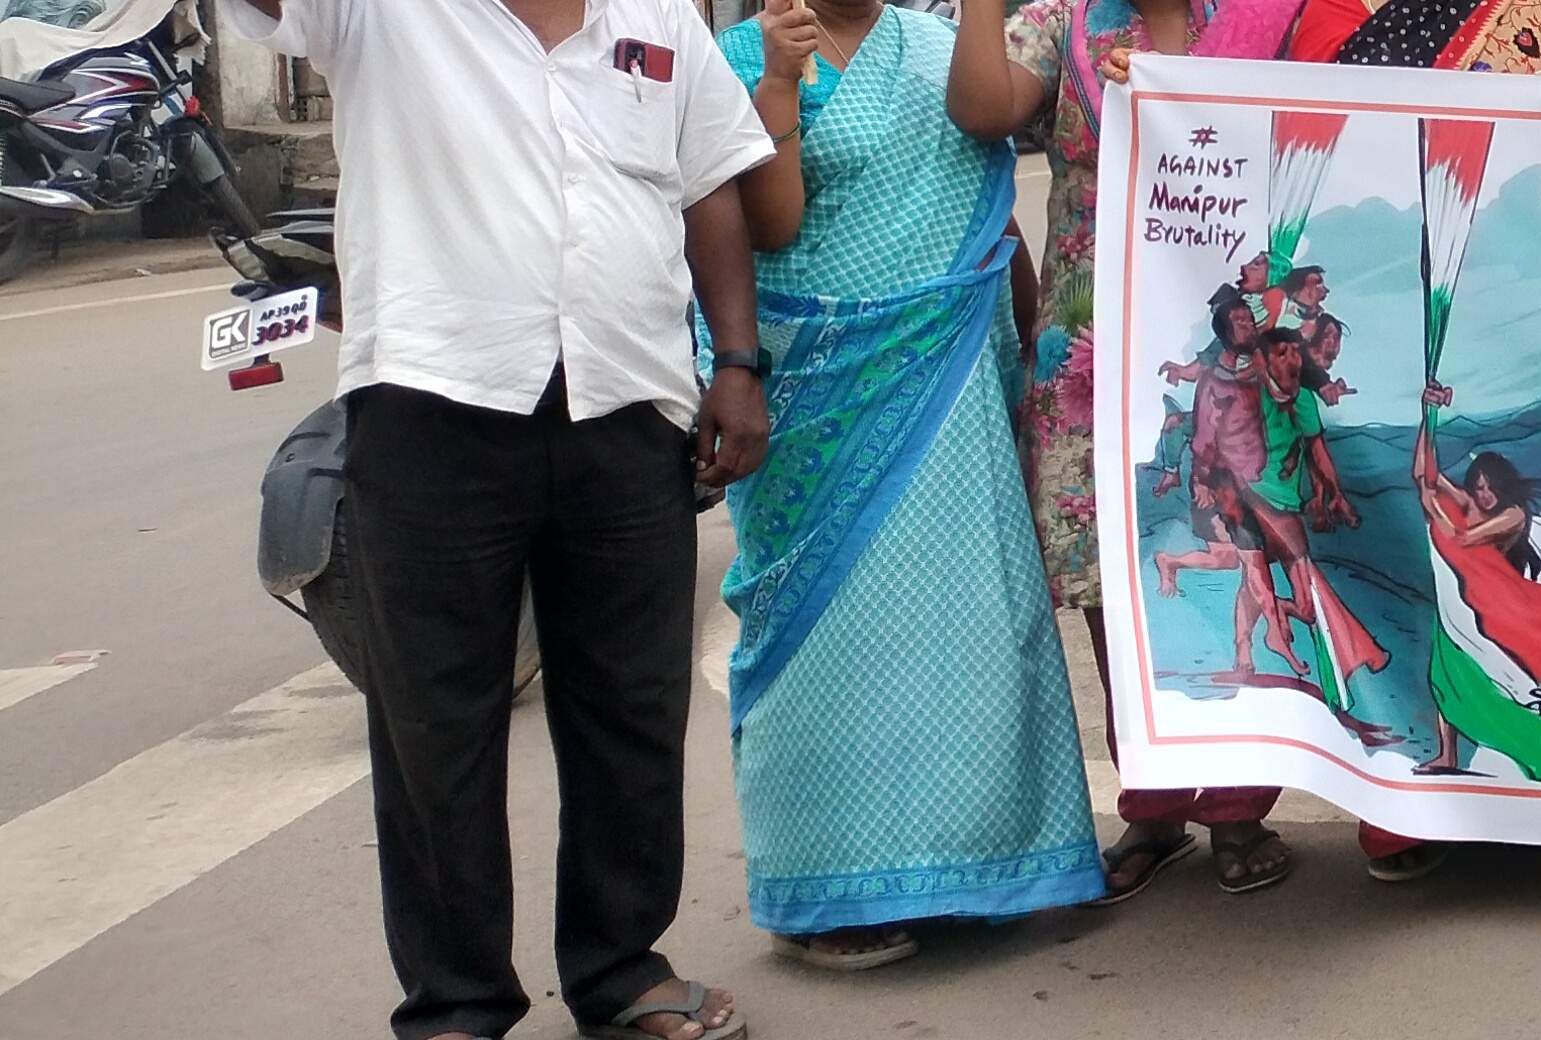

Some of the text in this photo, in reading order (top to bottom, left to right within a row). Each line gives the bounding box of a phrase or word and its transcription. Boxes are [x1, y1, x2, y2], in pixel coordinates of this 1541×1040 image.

[1157, 153, 1249, 179] AGAINST
[1148, 180, 1249, 224] Manipur
[1143, 217, 1247, 264] Brutality
[211, 311, 249, 350] GK
[251, 314, 310, 346] 3034
